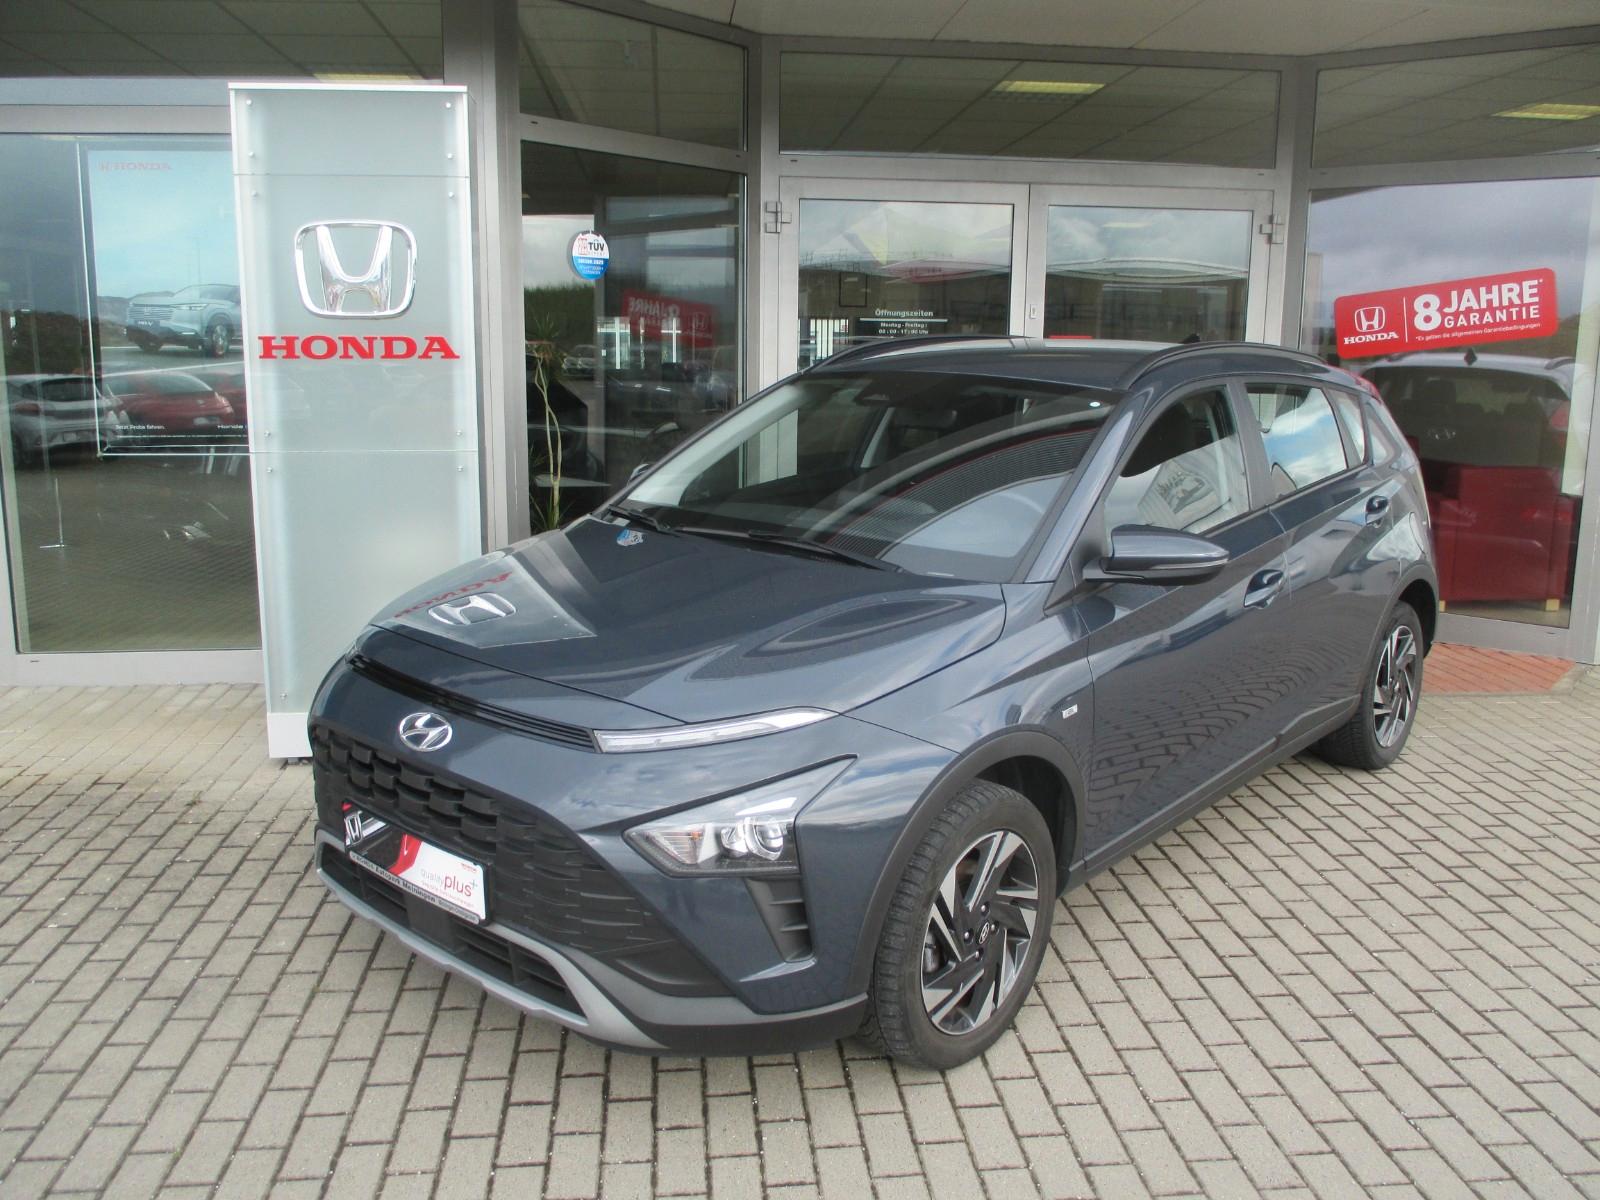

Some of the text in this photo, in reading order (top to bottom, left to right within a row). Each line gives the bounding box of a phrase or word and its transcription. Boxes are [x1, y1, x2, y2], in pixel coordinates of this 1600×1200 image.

[588, 239, 605, 251] TÜV
[875, 308, 934, 317] Öffnungszeiten
[1414, 294, 1442, 331] 8
[1444, 305, 1540, 329] GARANTIE
[1344, 330, 1399, 345] HONDA
[258, 335, 461, 360] HONDA
